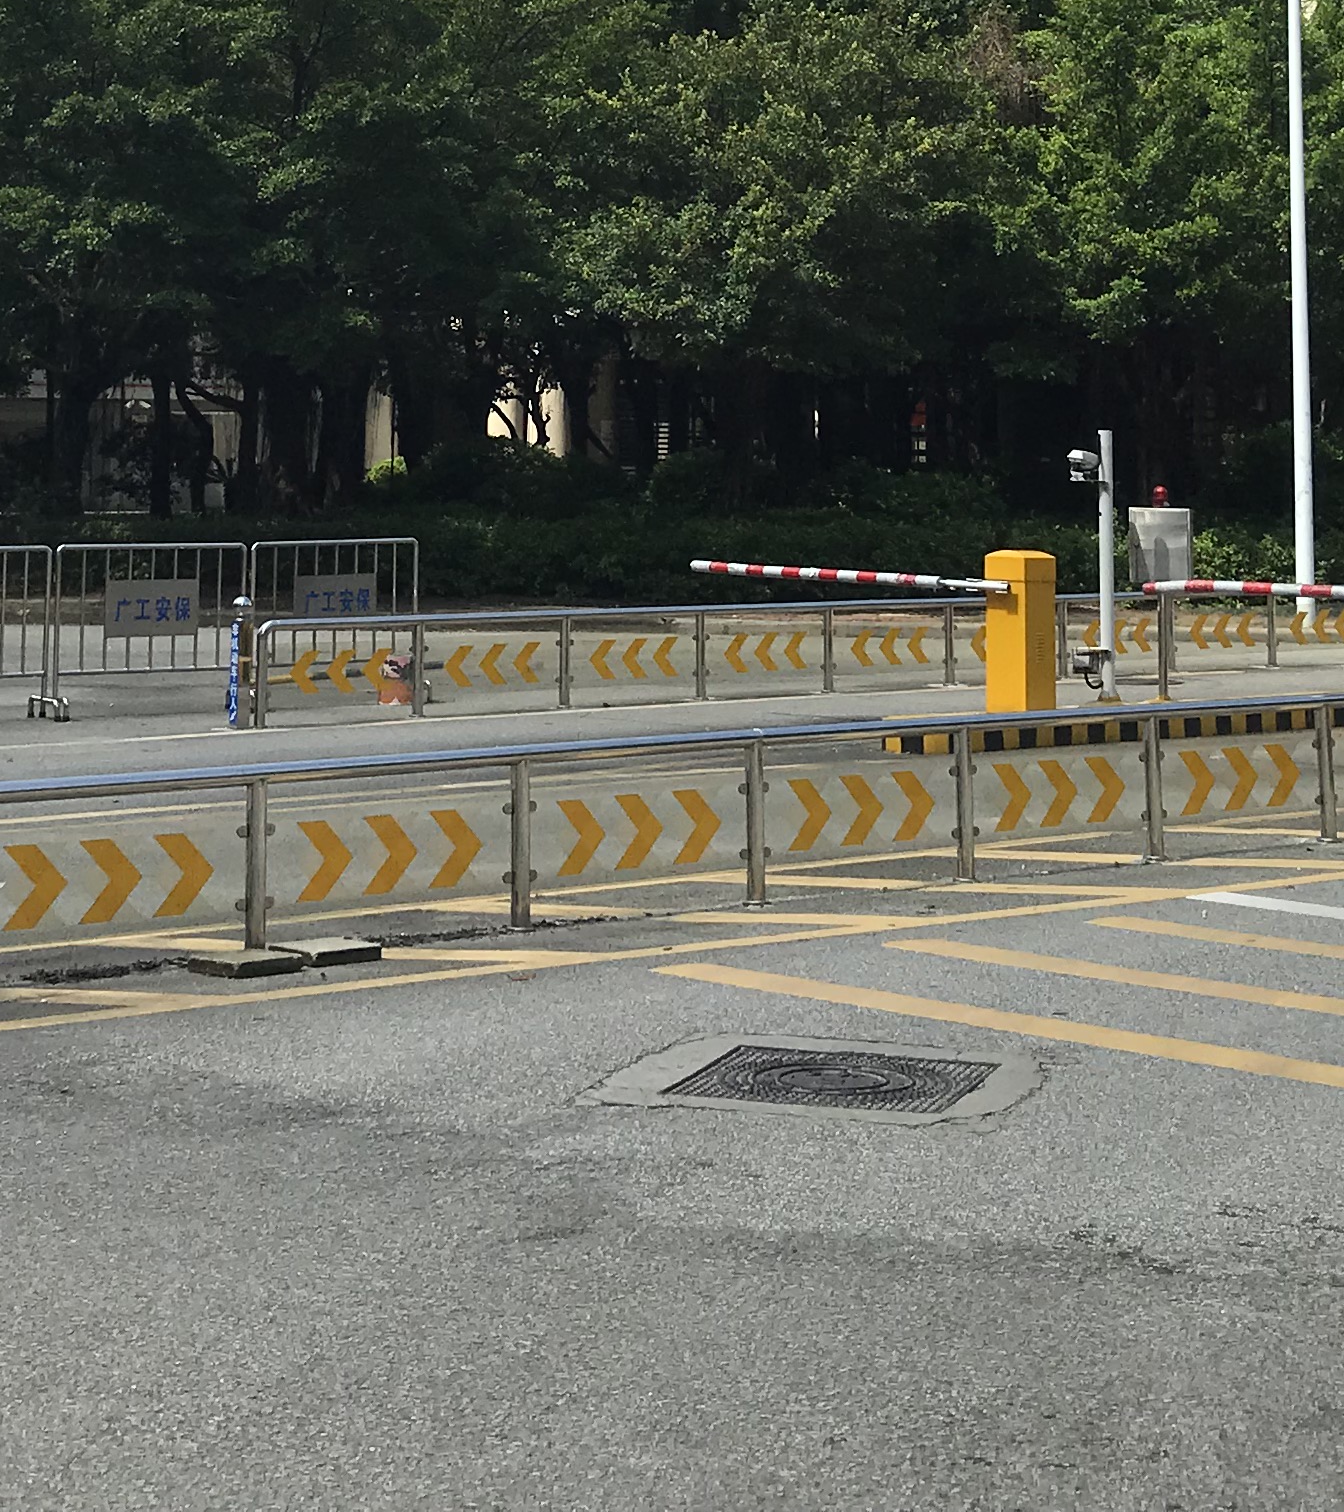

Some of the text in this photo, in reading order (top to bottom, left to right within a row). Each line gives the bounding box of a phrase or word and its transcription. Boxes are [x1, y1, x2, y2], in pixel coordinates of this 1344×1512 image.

[114, 595, 191, 622] 广工安保
[304, 587, 370, 614] 广工安保
